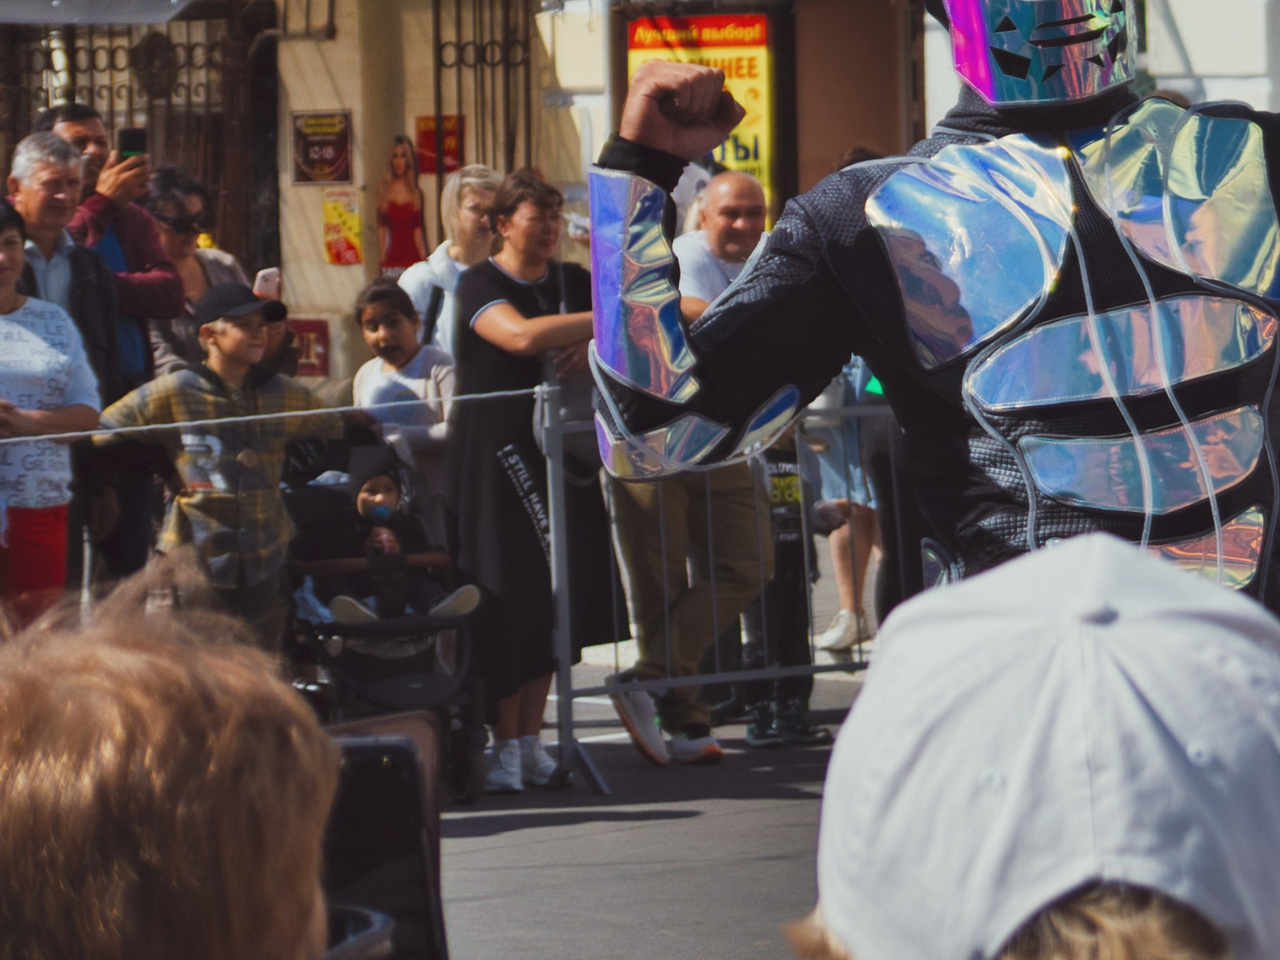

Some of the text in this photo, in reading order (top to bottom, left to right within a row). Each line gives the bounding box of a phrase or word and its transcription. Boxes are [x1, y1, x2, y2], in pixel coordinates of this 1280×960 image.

[702, 22, 762, 43] выбор!
[507, 453, 533, 491] STILL
[528, 492, 549, 529] HAVE
